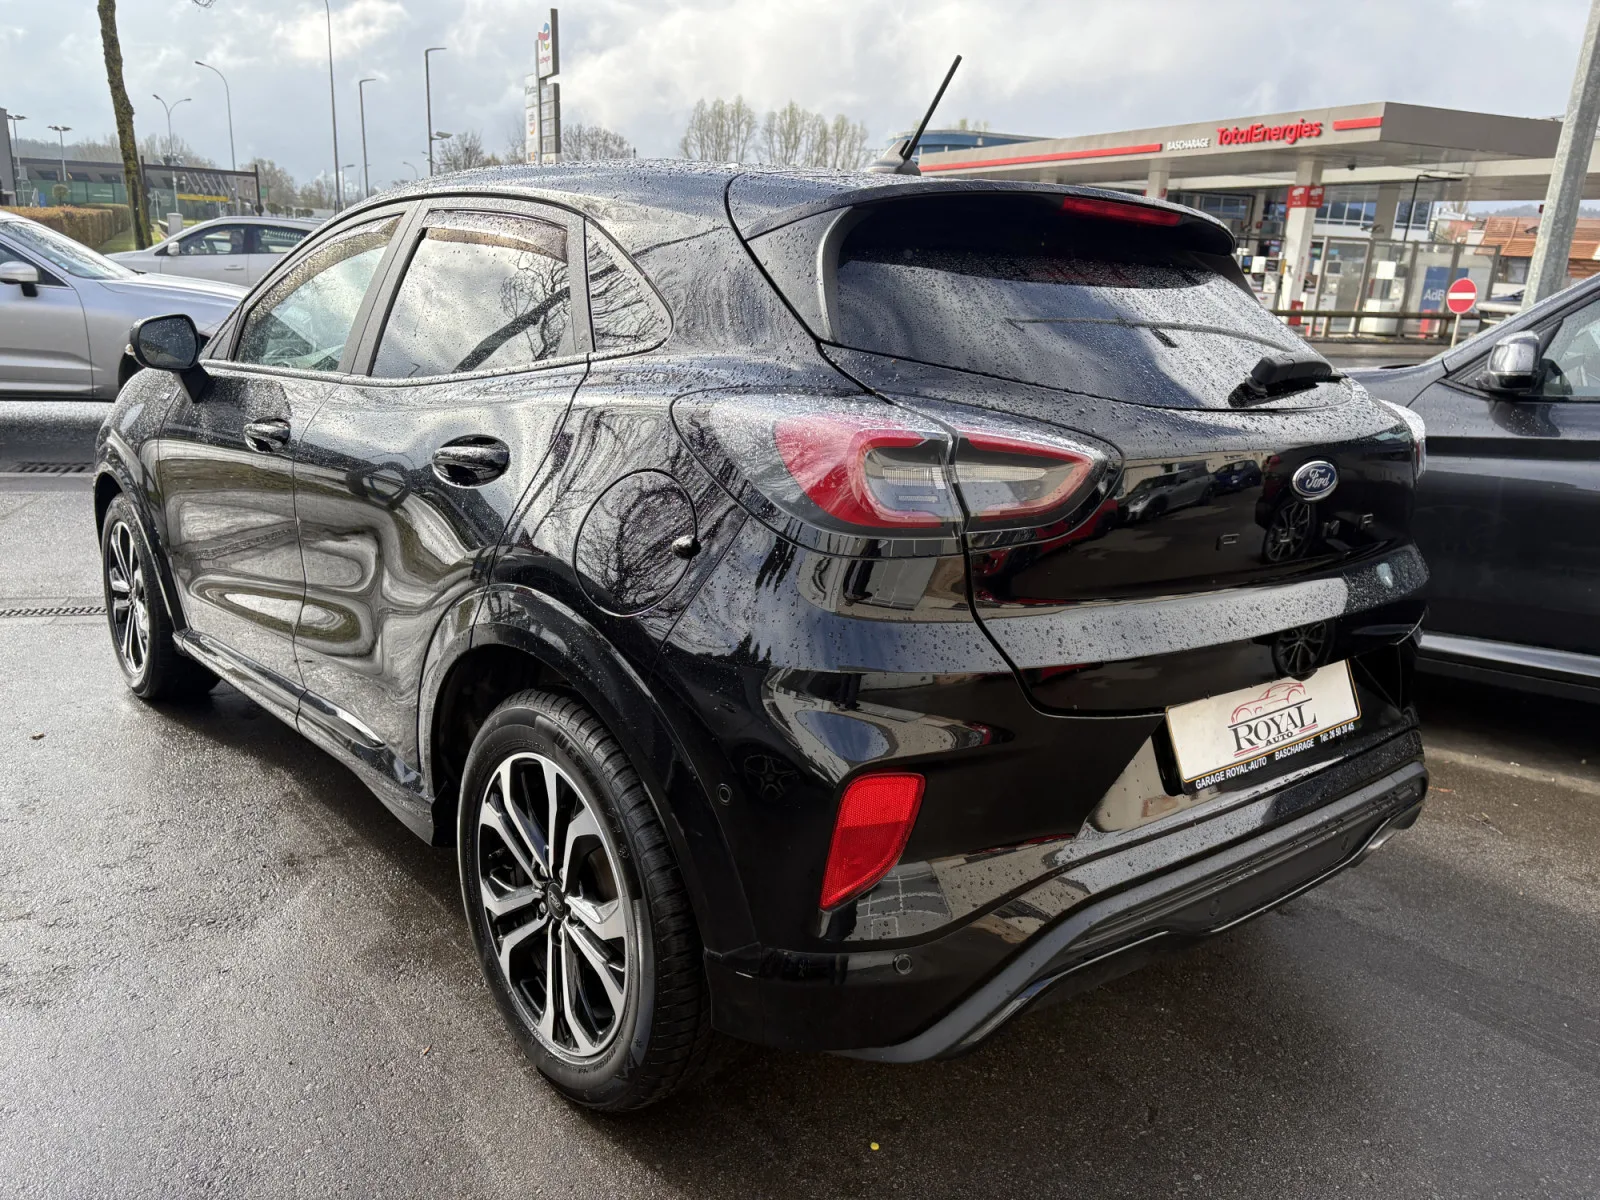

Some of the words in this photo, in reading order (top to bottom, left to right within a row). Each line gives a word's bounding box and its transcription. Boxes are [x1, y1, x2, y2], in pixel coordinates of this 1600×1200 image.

[1166, 137, 1210, 151] BASCHARAGE
[1216, 118, 1323, 145] TotalEnergies
[1423, 288, 1445, 301] AdB
[1305, 468, 1331, 489] Ford
[1230, 704, 1317, 752] ROYAL
[1265, 731, 1294, 747] AUTO
[1195, 771, 1225, 790] GARAGE
[1226, 756, 1267, 779] ROYAL-AUTO
[1275, 738, 1315, 761] BASCHARAGE
